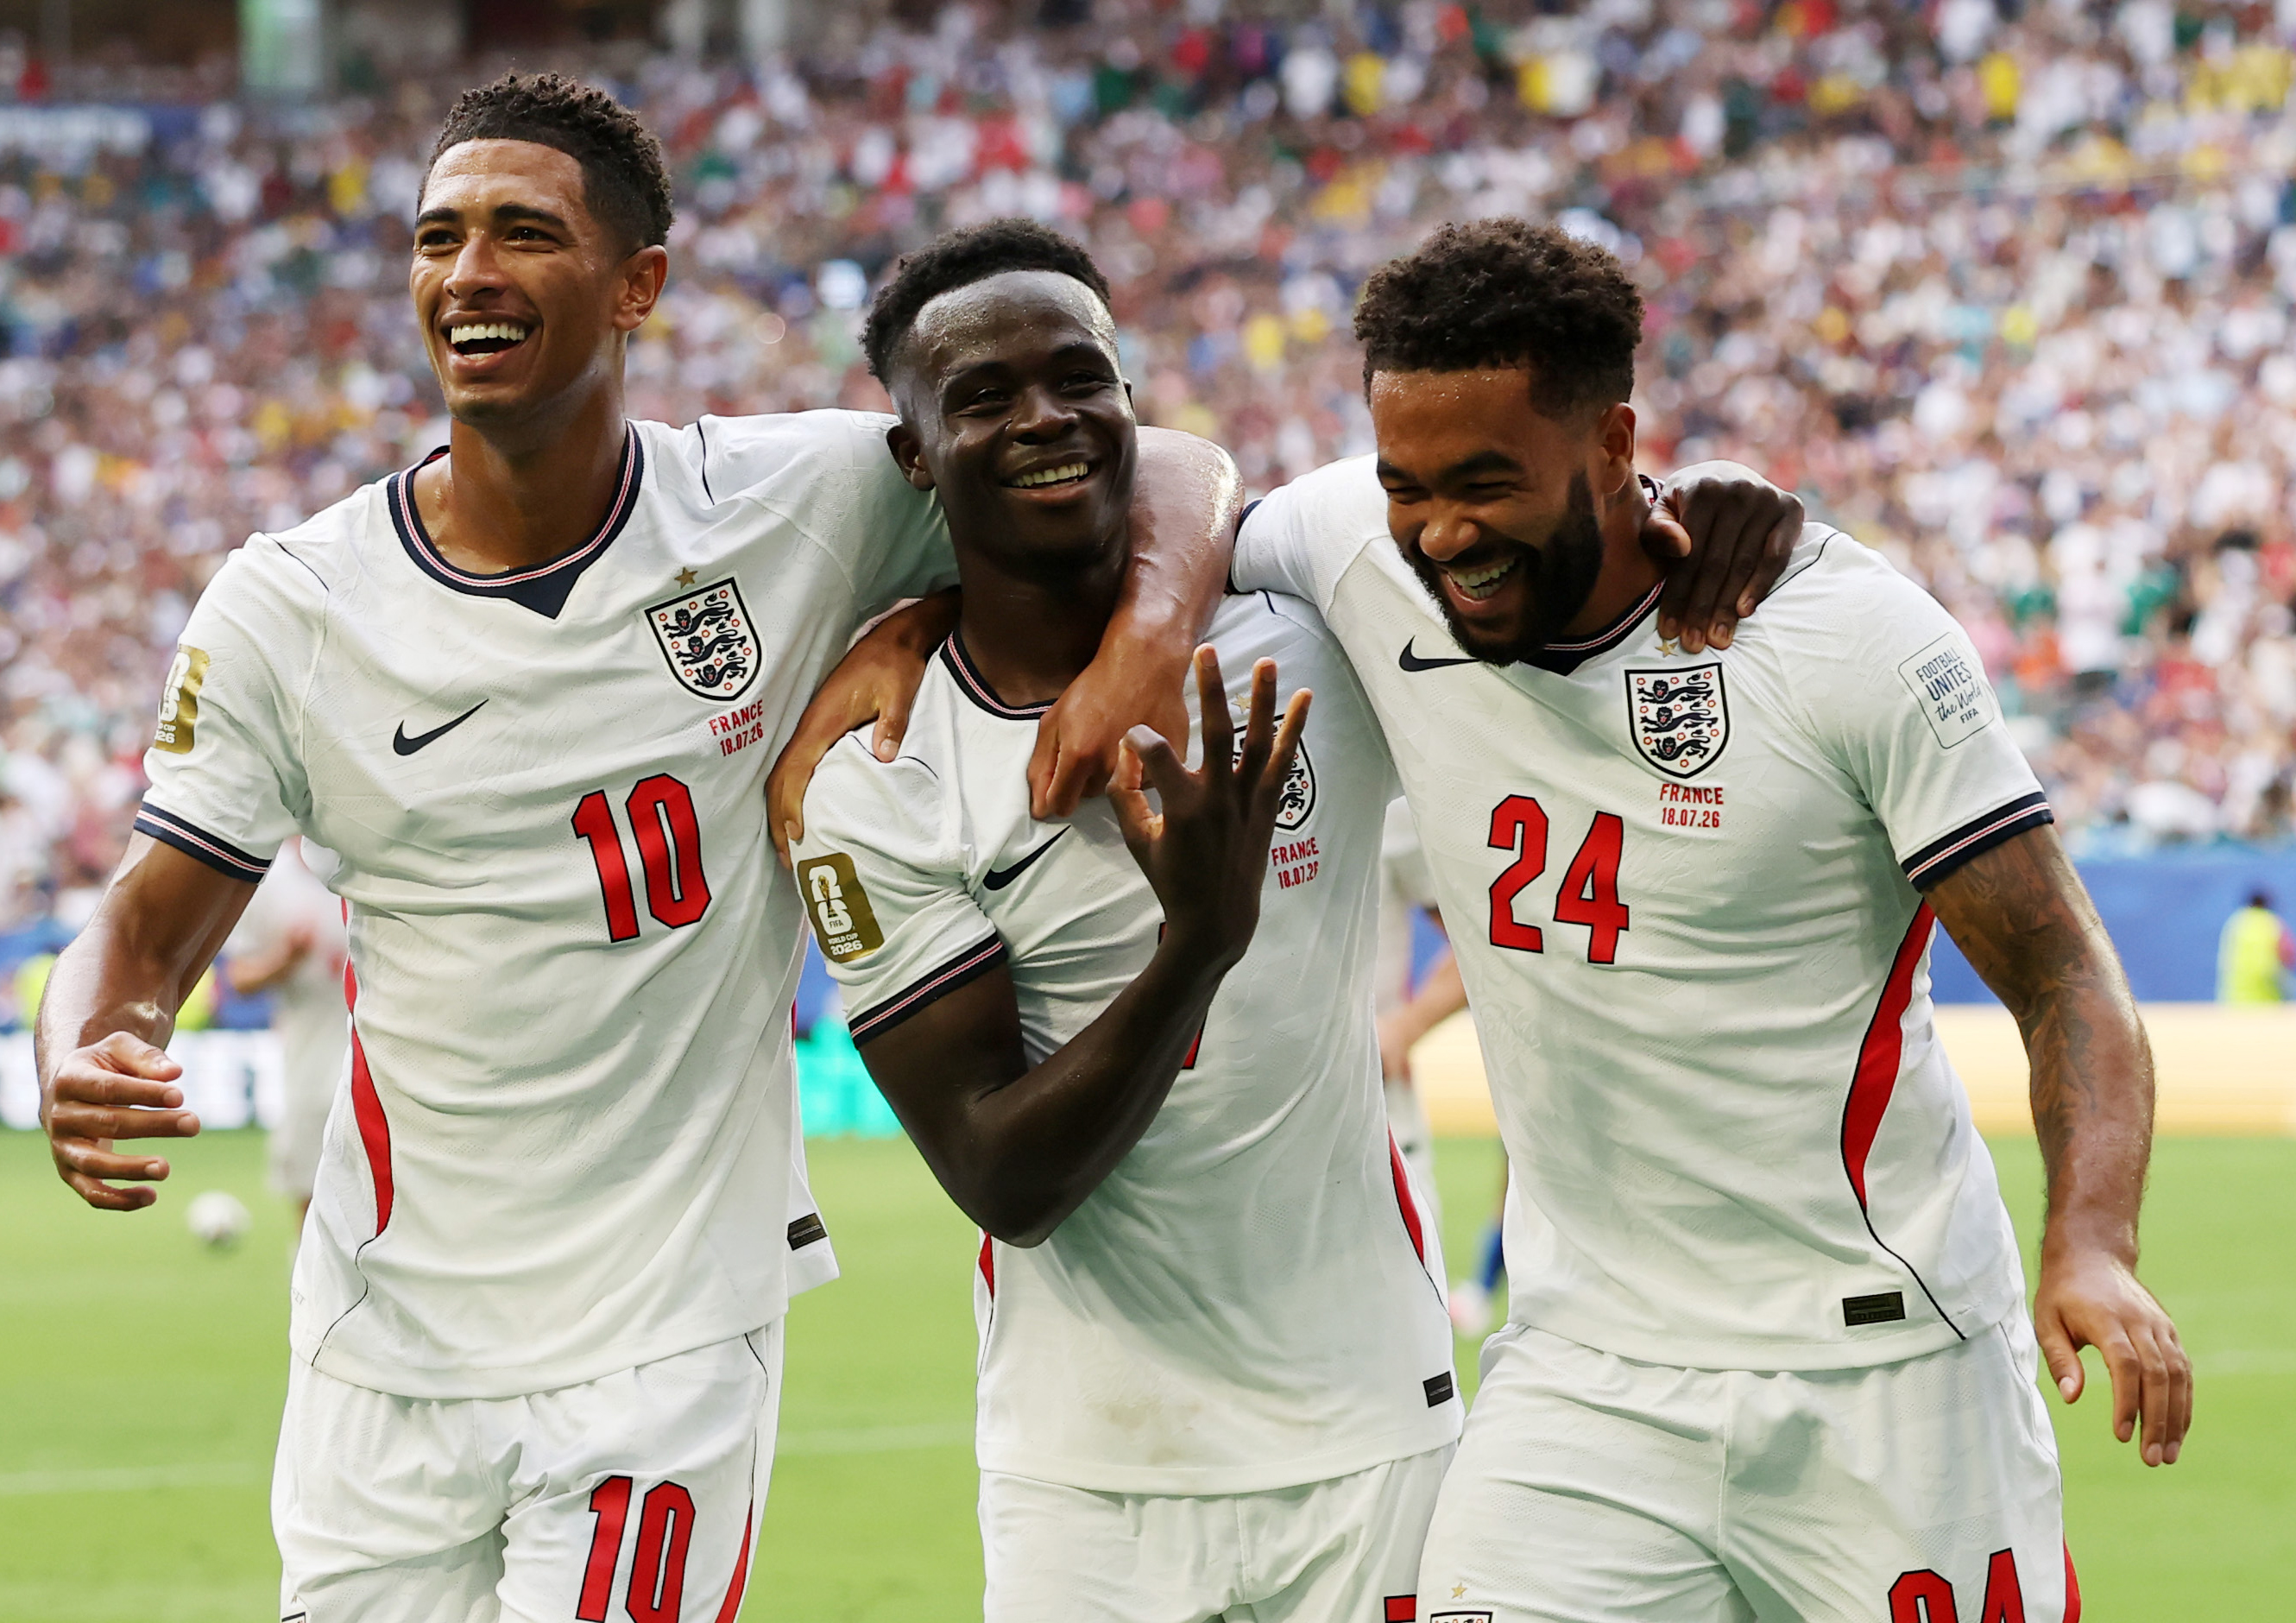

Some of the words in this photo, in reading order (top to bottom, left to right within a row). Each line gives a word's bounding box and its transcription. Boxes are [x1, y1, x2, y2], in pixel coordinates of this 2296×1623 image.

[1915, 646, 1961, 683] FOOTBALL
[1925, 661, 1972, 701] UNITES
[1935, 701, 1957, 722] the
[1954, 679, 1984, 709] World
[1960, 708, 1979, 723] FIFA
[709, 700, 763, 736] FRANCE
[720, 723, 764, 757] 18.07.26
[1660, 783, 1724, 805] FRANCE
[1662, 807, 1720, 828] 18.07.26
[571, 773, 712, 943] 10
[1271, 837, 1319, 867] FRANCE
[1487, 794, 1630, 965] 24
[829, 919, 844, 929] FIFA
[846, 932, 859, 941] CUP
[830, 940, 863, 956] 2026
[576, 1475, 696, 1623] 10
